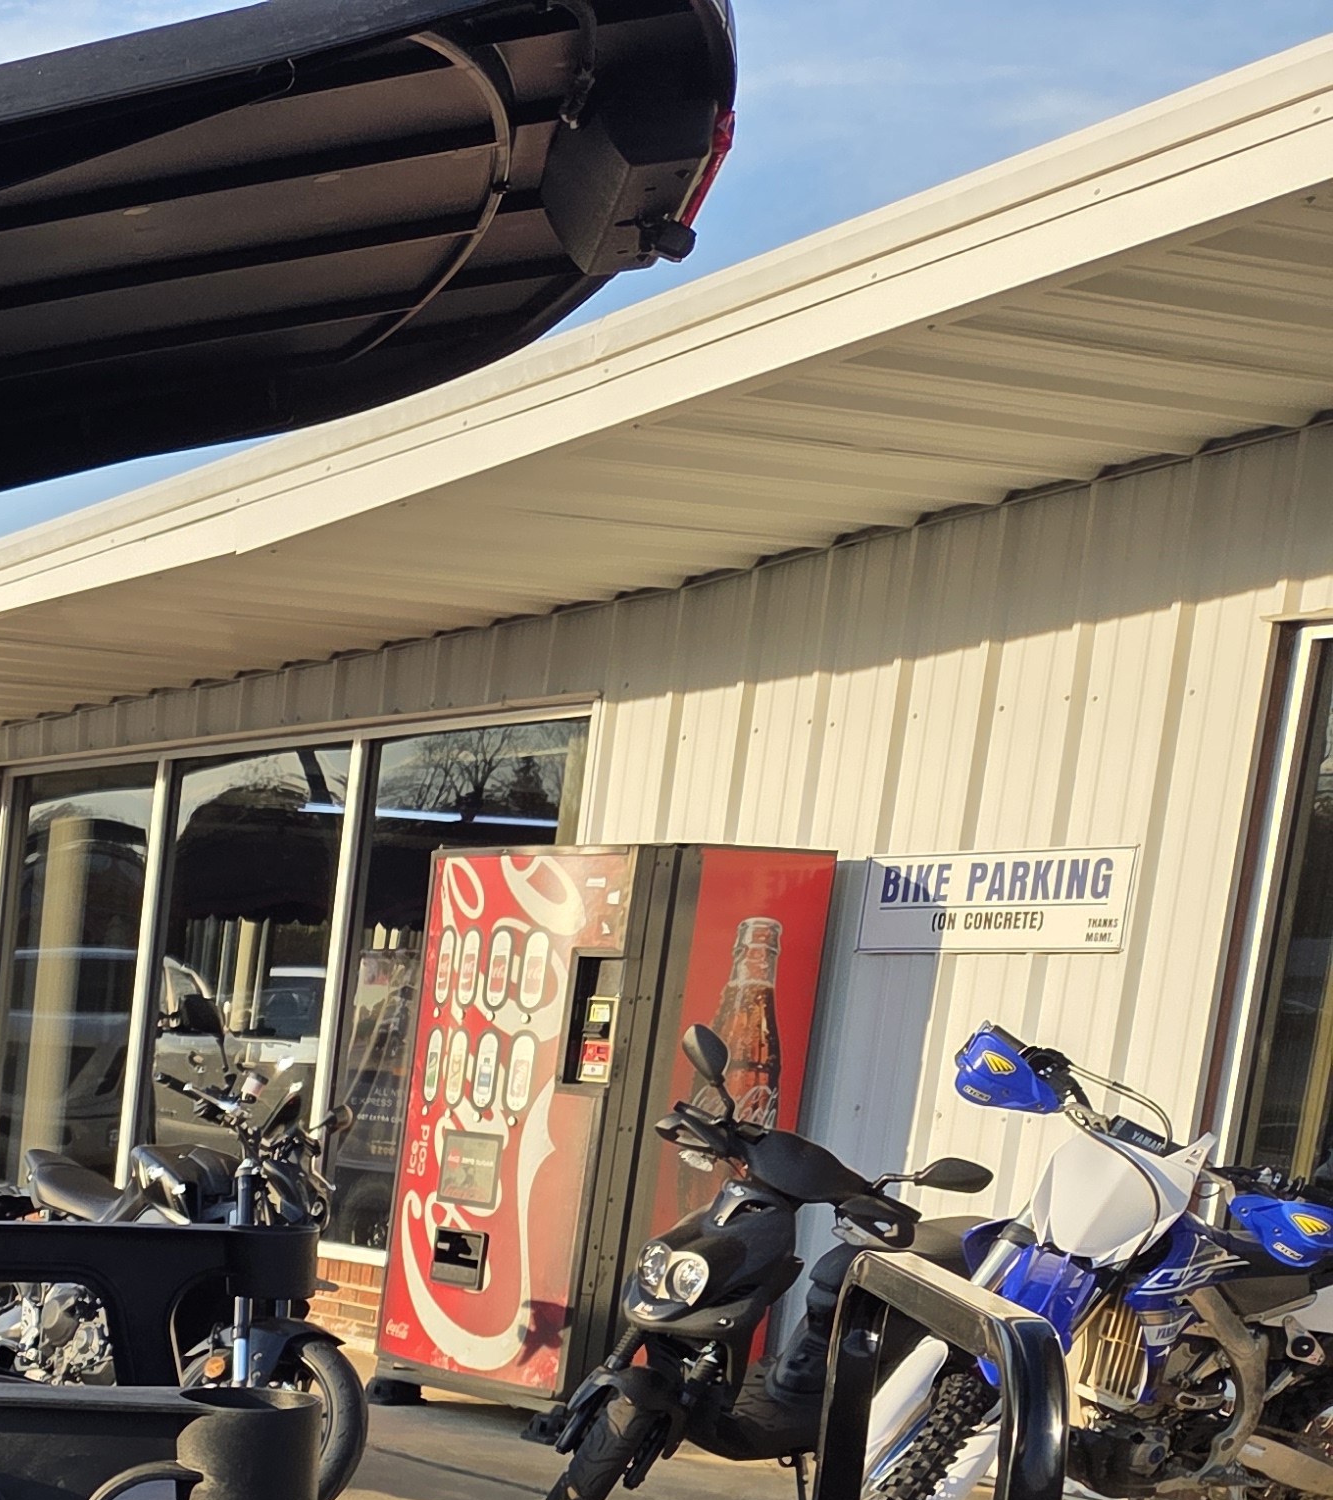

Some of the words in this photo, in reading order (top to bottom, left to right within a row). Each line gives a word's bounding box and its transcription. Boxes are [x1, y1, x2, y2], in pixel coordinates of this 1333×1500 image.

[880, 863, 952, 903] BIKE
[965, 857, 1114, 902] PARKING
[931, 912, 957, 932] (ON
[964, 911, 1044, 932] CONCRETE)
[1087, 918, 1118, 928] THANKS
[1085, 932, 1114, 943] MGMT.
[417, 1124, 430, 1176] cold
[1131, 1130, 1165, 1153] YAMAH
